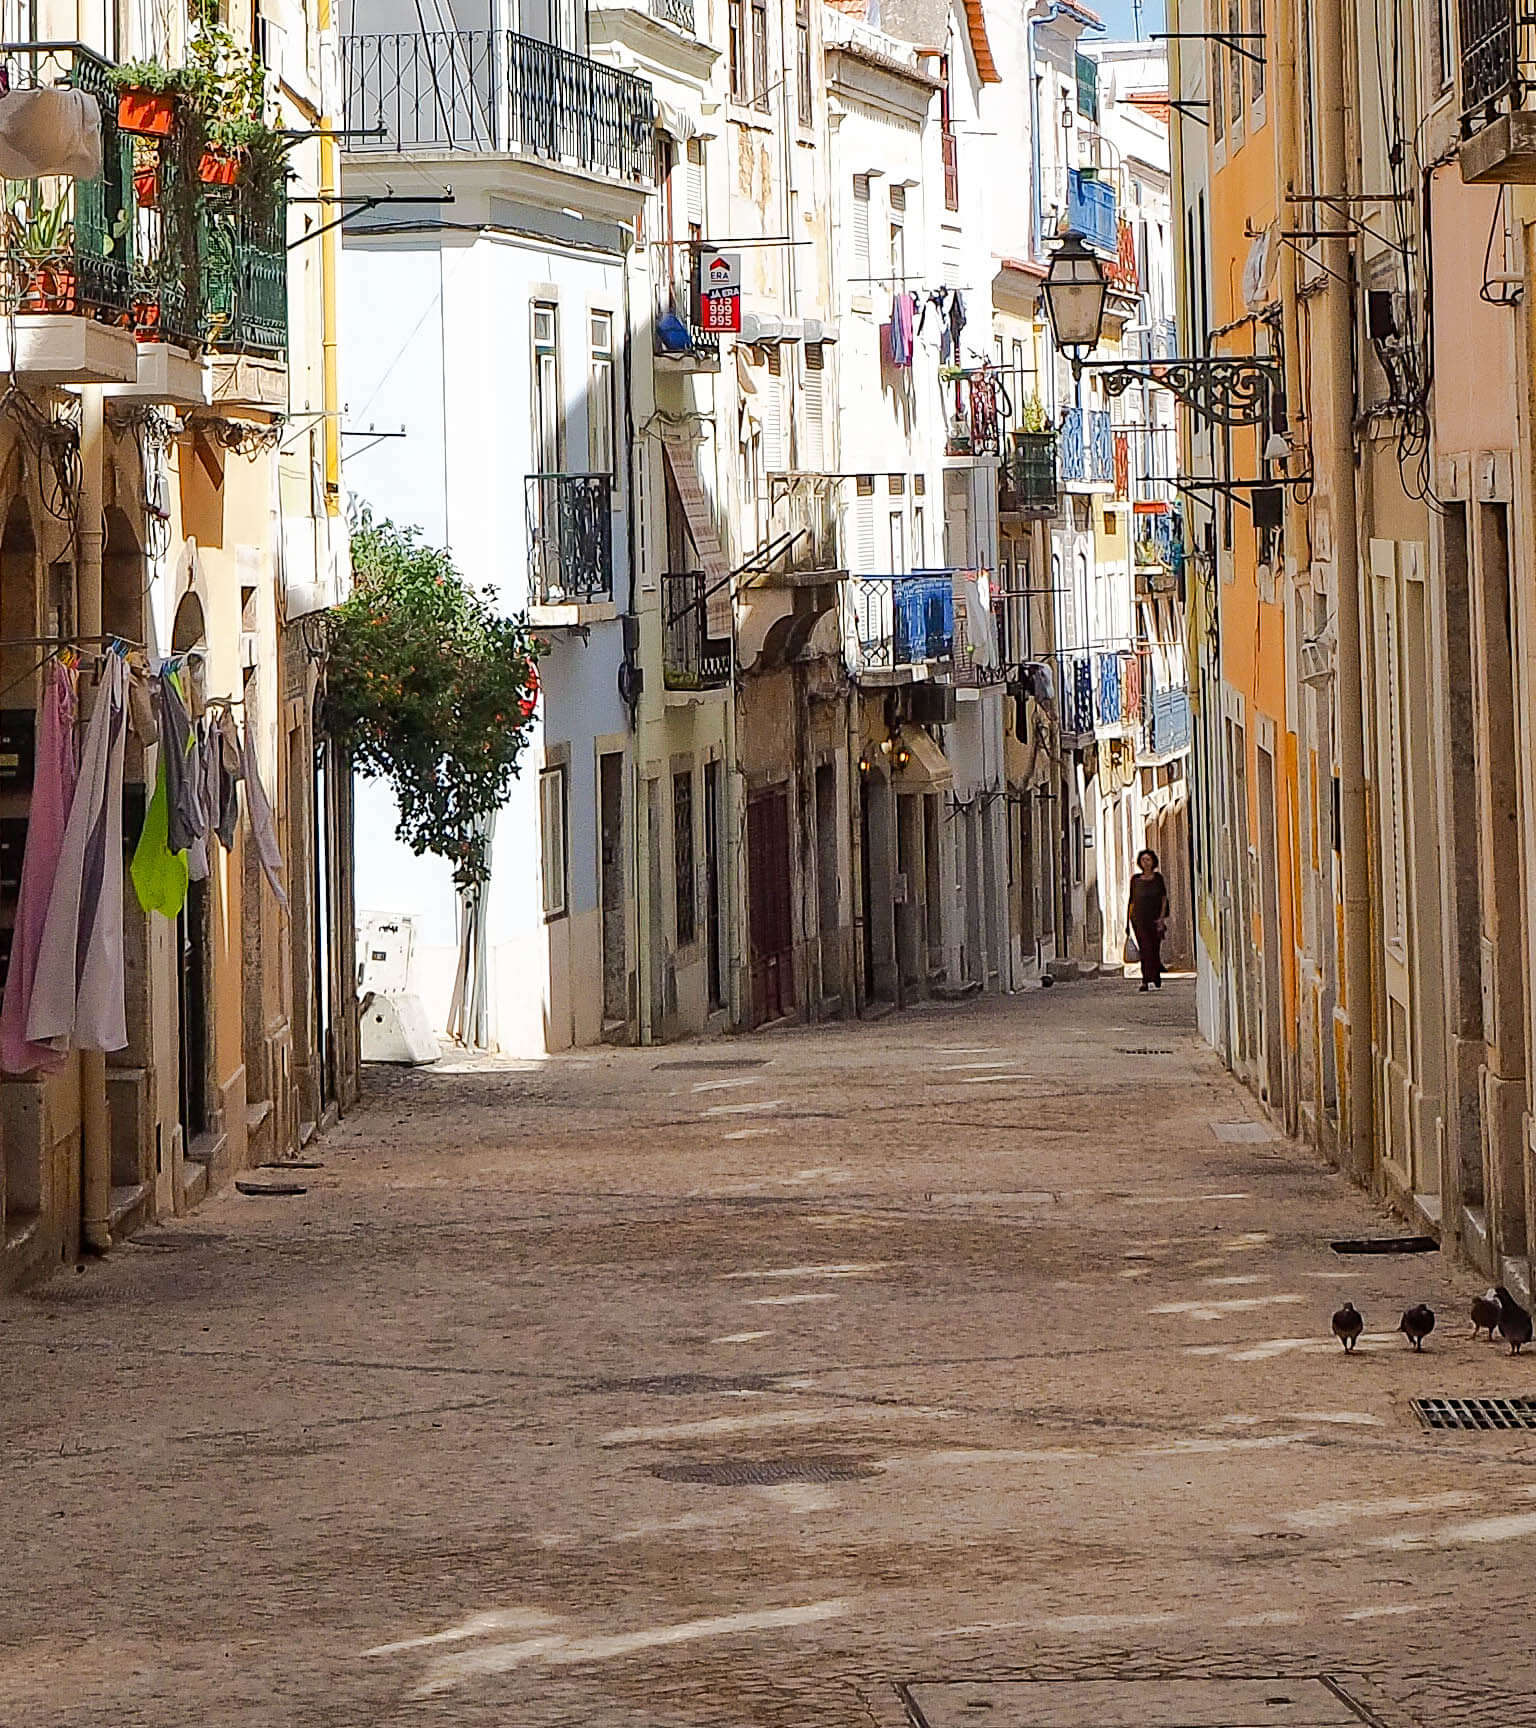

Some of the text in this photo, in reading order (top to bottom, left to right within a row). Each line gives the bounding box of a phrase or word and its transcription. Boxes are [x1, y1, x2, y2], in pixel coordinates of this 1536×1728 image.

[711, 271, 729, 279] ERA
[709, 305, 732, 315] 999
[709, 315, 732, 325] 995
